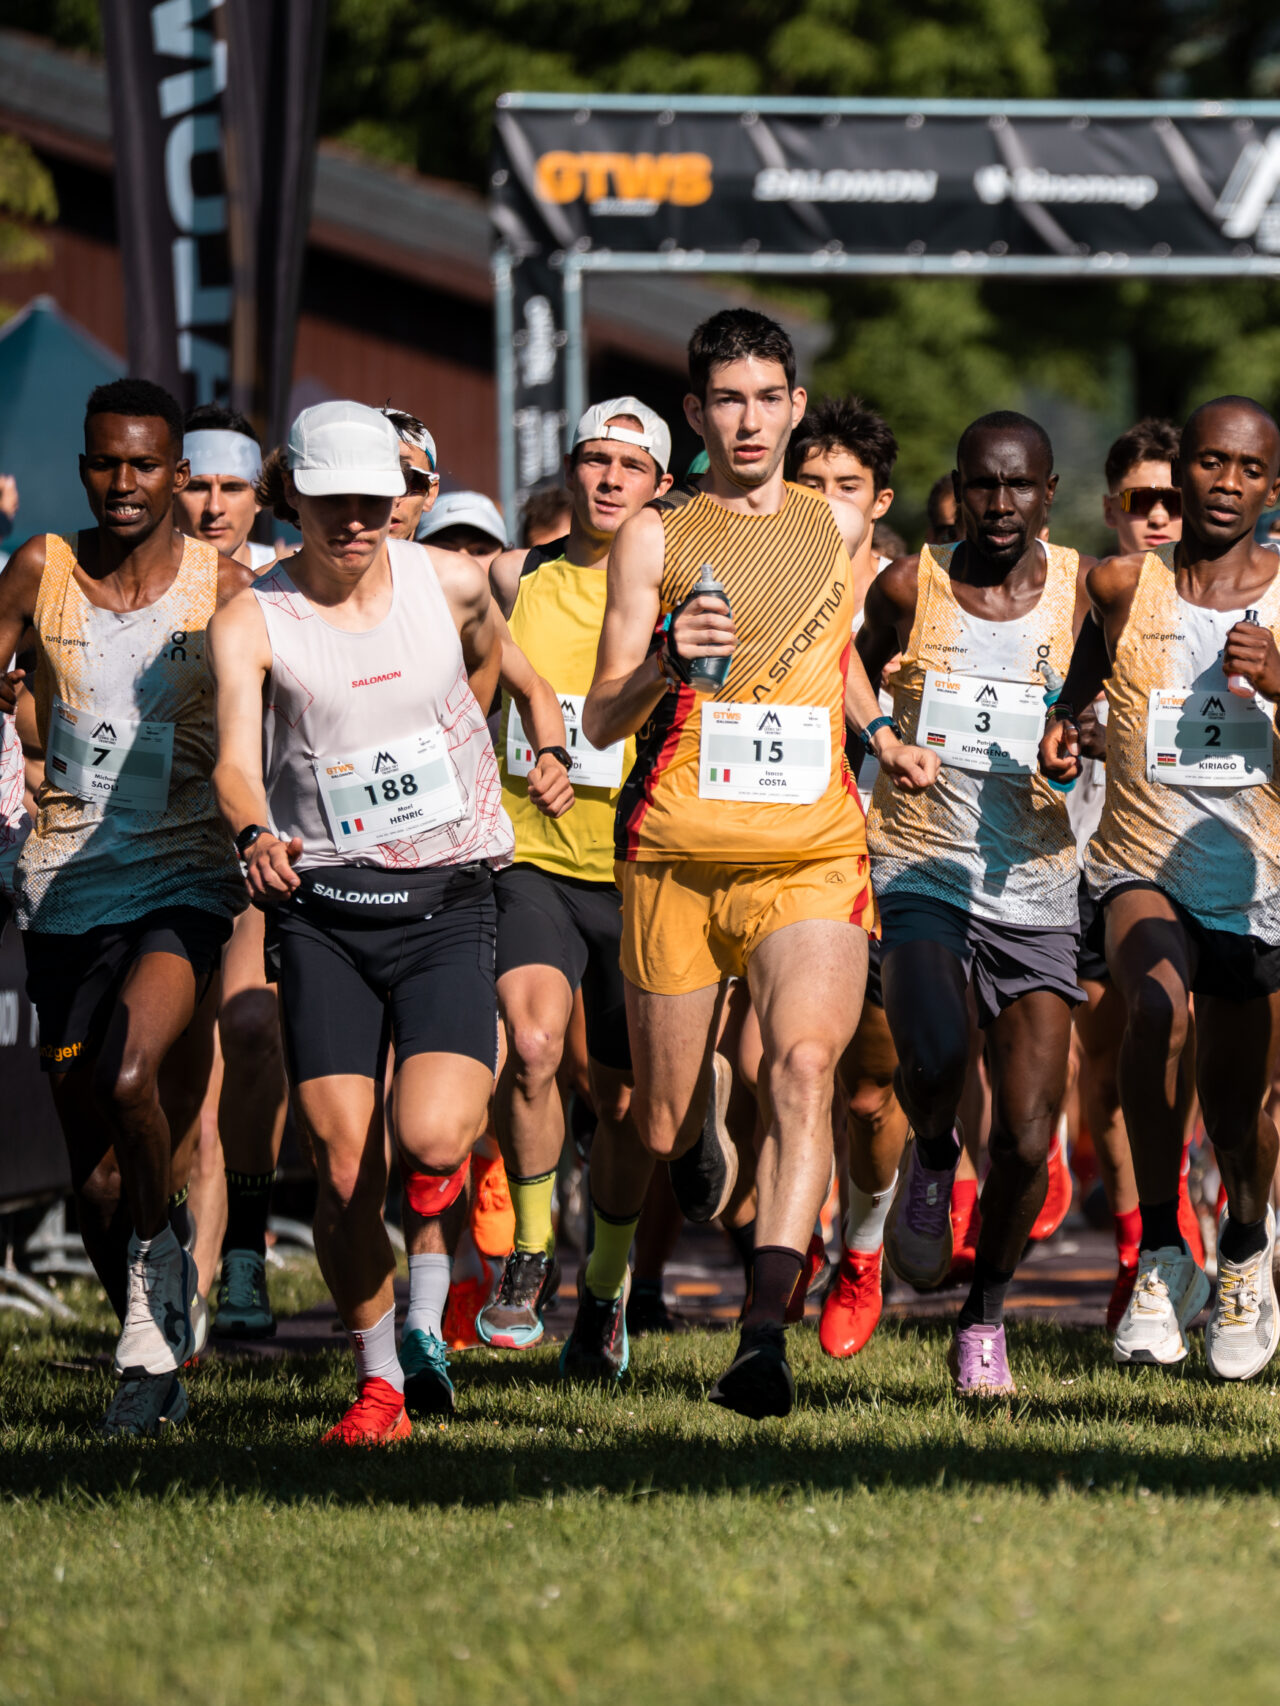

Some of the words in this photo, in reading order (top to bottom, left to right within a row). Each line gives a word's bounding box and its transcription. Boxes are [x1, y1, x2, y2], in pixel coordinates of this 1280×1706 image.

[534, 150, 714, 206] GTWS
[753, 168, 939, 202] SALOMON
[1142, 632, 1186, 641] run2gether
[924, 643, 968, 654] run2gether
[351, 670, 402, 688] SALOMON
[935, 680, 961, 690] GTWS
[713, 711, 742, 721] GTWS
[974, 711, 991, 732] 3
[1204, 724, 1221, 747] 2
[91, 747, 112, 766] 7
[753, 739, 784, 763] 15
[961, 745, 1009, 758] KIPNGENO
[326, 763, 355, 775] GTWS
[1199, 762, 1237, 770] KIRIAGO
[91, 780, 119, 792] SAOLI
[364, 773, 418, 806] 188
[758, 778, 787, 787] COSTA
[389, 808, 424, 825] HENRIC
[313, 883, 410, 905] SALOMON
